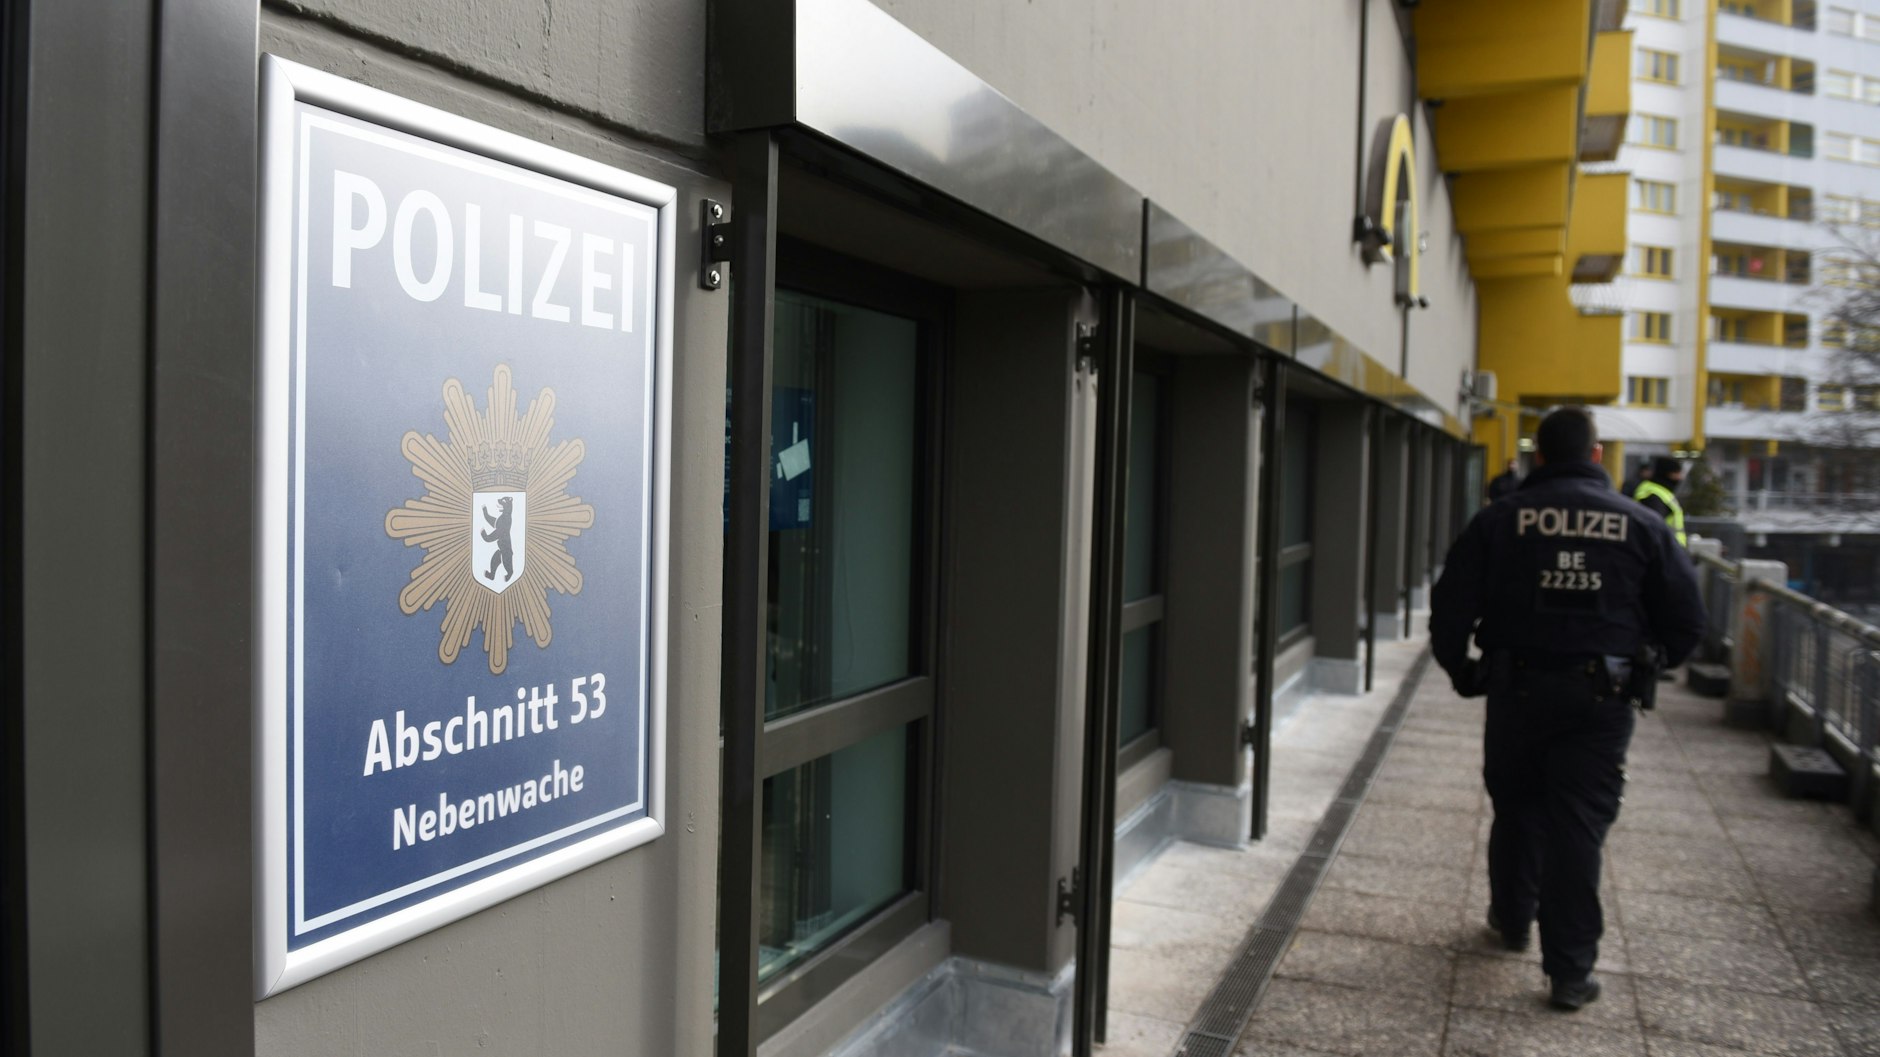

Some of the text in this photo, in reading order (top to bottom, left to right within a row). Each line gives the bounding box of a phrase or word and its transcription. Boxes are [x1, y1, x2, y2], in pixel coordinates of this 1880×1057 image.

[332, 169, 634, 333] POLIZEI
[1517, 507, 1628, 541] POLIZEI
[1540, 570, 1602, 591] 22235
[1557, 551, 1586, 570] BE
[363, 672, 607, 777] Abschnitt 53
[392, 759, 585, 851] Nebenwache
